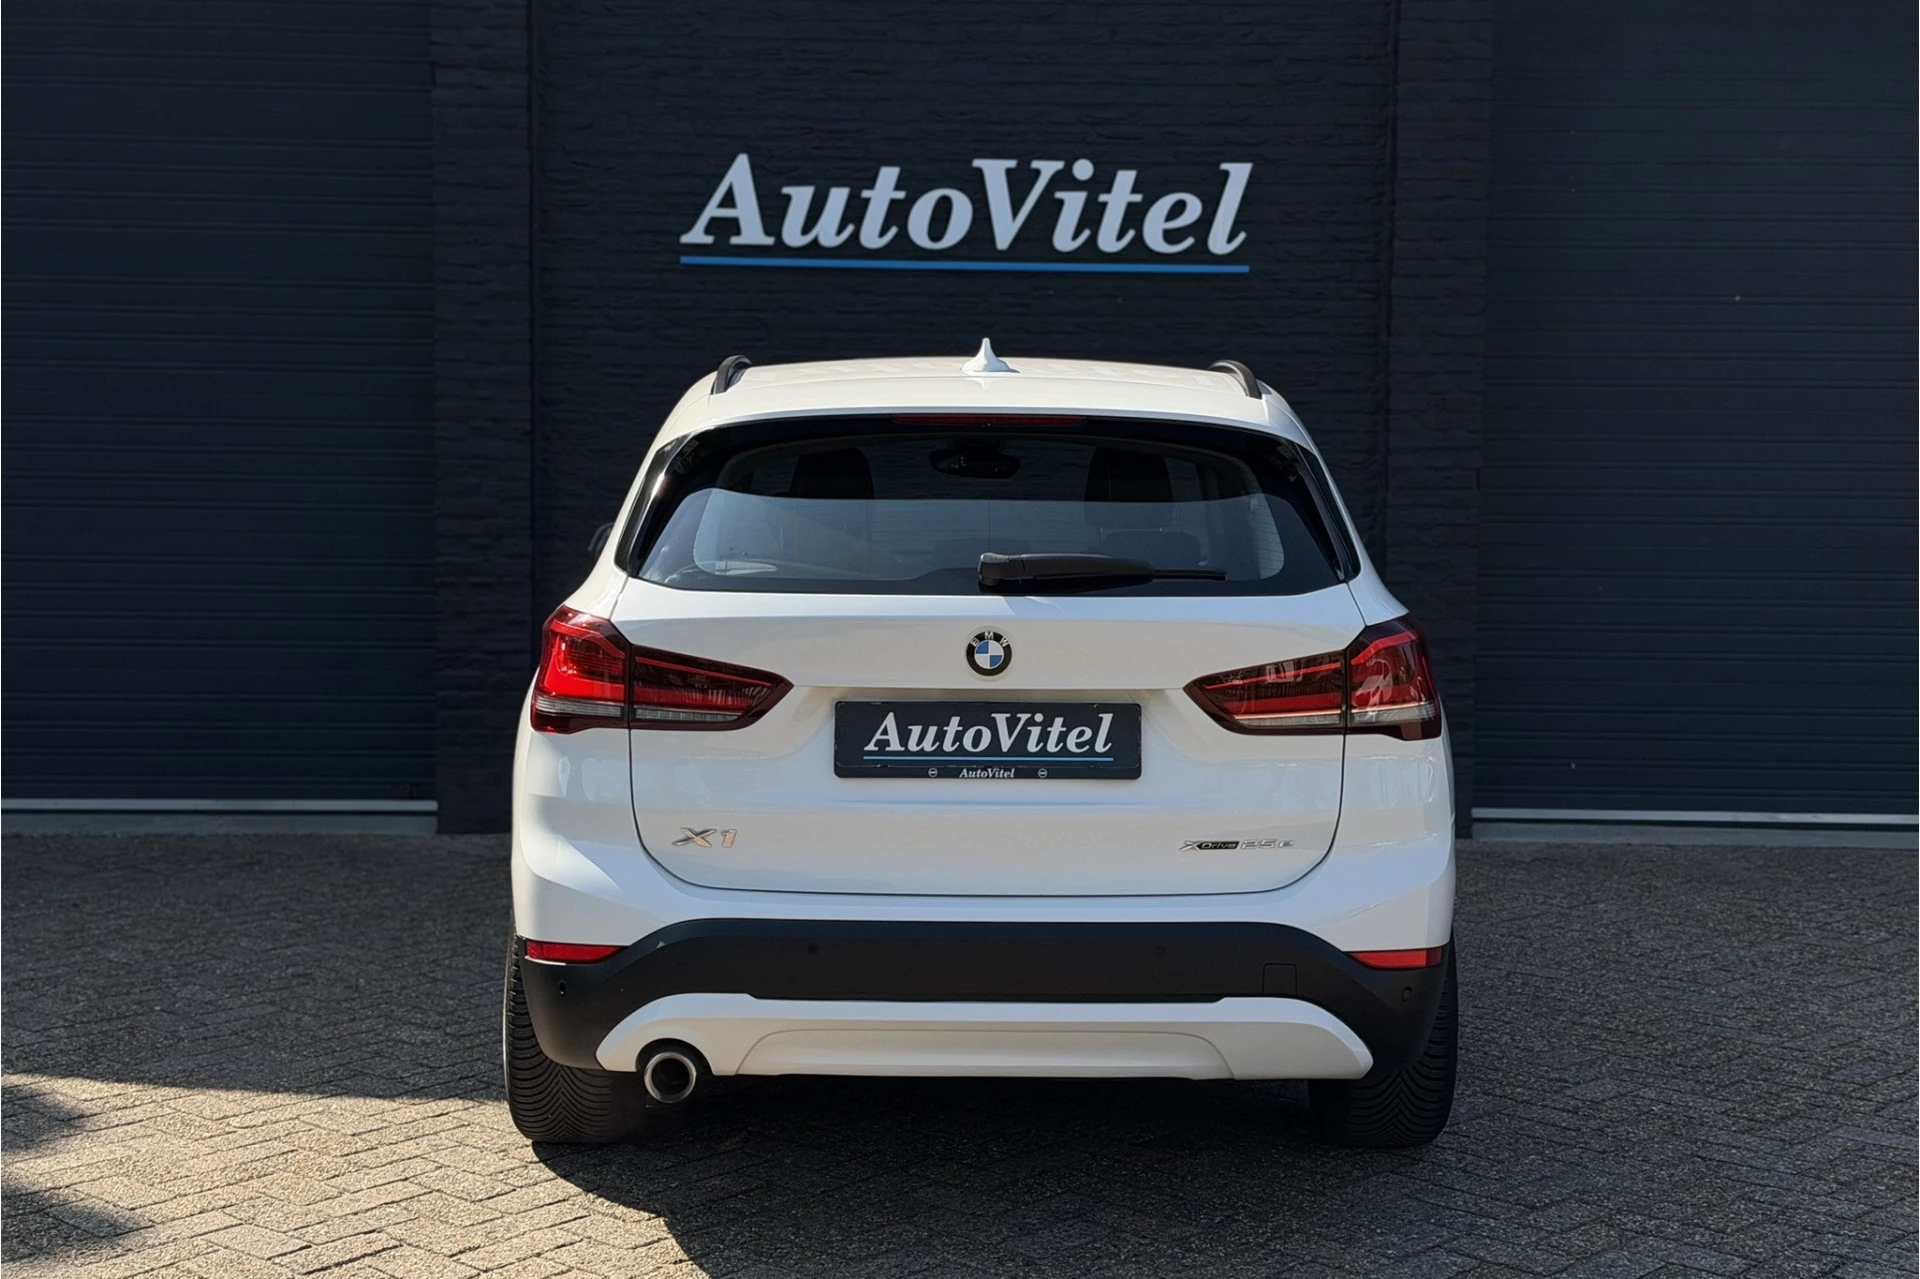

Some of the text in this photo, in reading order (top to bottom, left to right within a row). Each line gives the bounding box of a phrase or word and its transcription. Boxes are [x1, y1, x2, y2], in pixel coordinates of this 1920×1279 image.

[679, 152, 1253, 255] AutoVitel
[969, 631, 1010, 648] BMW
[863, 711, 1114, 754] AutoVitel
[958, 767, 1016, 779] AutoVitel
[672, 826, 738, 849] X1
